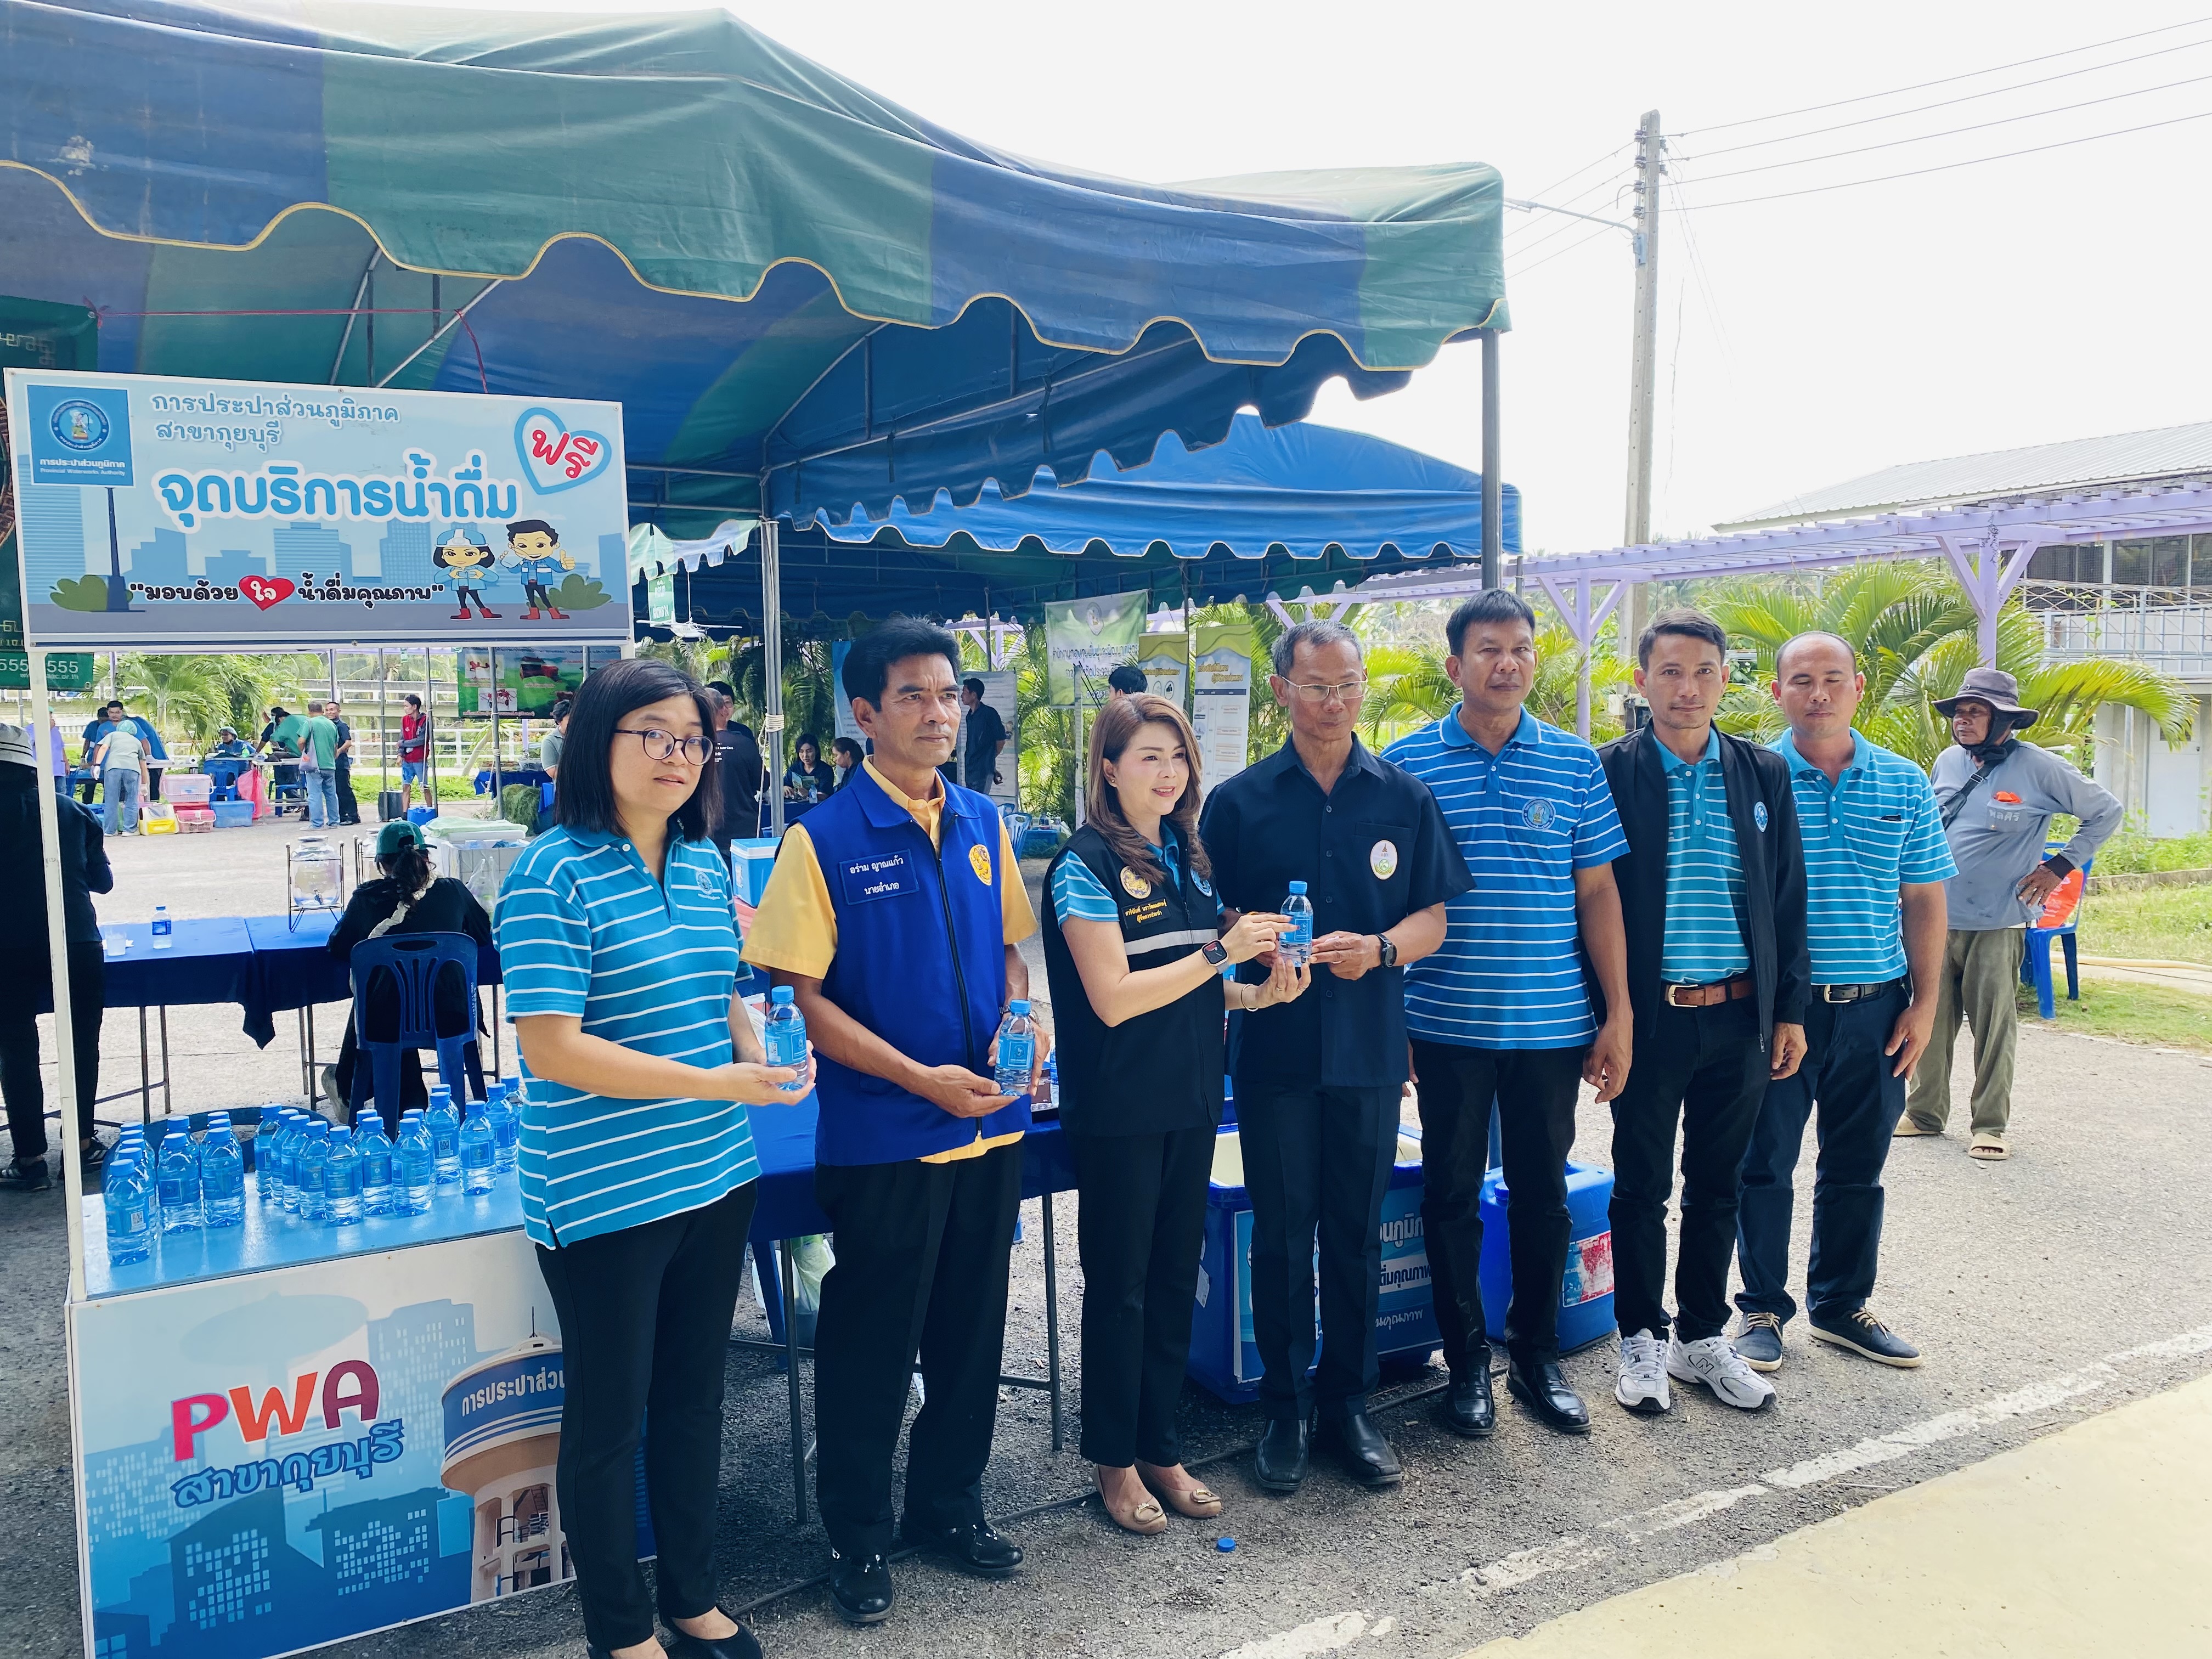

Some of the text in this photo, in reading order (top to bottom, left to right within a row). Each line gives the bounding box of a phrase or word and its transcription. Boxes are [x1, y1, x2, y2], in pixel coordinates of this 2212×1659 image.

[153, 393, 399, 427] การประปาส่วนภูมิภาค
[157, 421, 280, 450] สาขากุยบุรี
[40, 458, 125, 469] การประปาส่วนภูมิภาค
[532, 429, 599, 479] ฟรี
[159, 454, 516, 527] จุดบริการน้ำดื่ม
[250, 580, 276, 601] ใจ
[849, 855, 904, 874] อร่าม ญาณแก้ว
[864, 881, 900, 895] นายอำเภอ
[171, 1359, 380, 1462] PWA
[170, 1418, 405, 1508] สาขากุยบุรี
